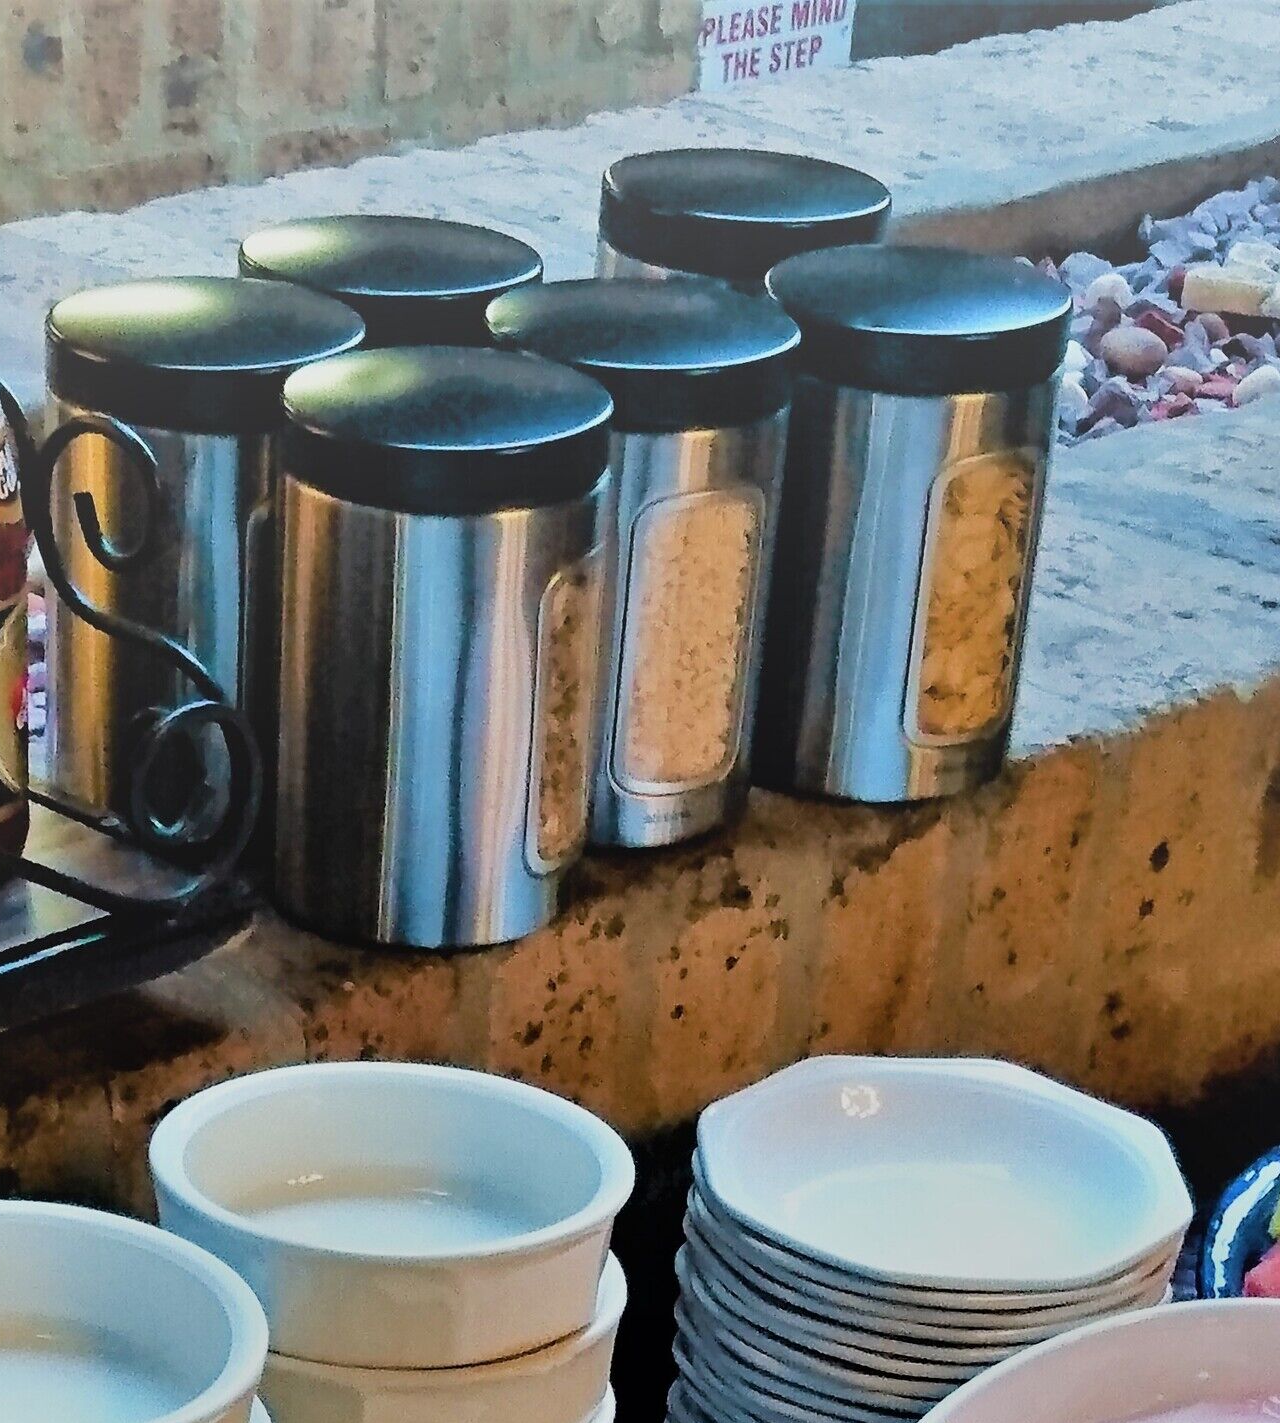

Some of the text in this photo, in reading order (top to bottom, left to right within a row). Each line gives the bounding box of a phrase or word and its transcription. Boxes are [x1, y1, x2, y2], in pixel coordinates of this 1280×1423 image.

[699, 0, 847, 46] PLEASE MIND
[722, 35, 823, 83] THE STEP
